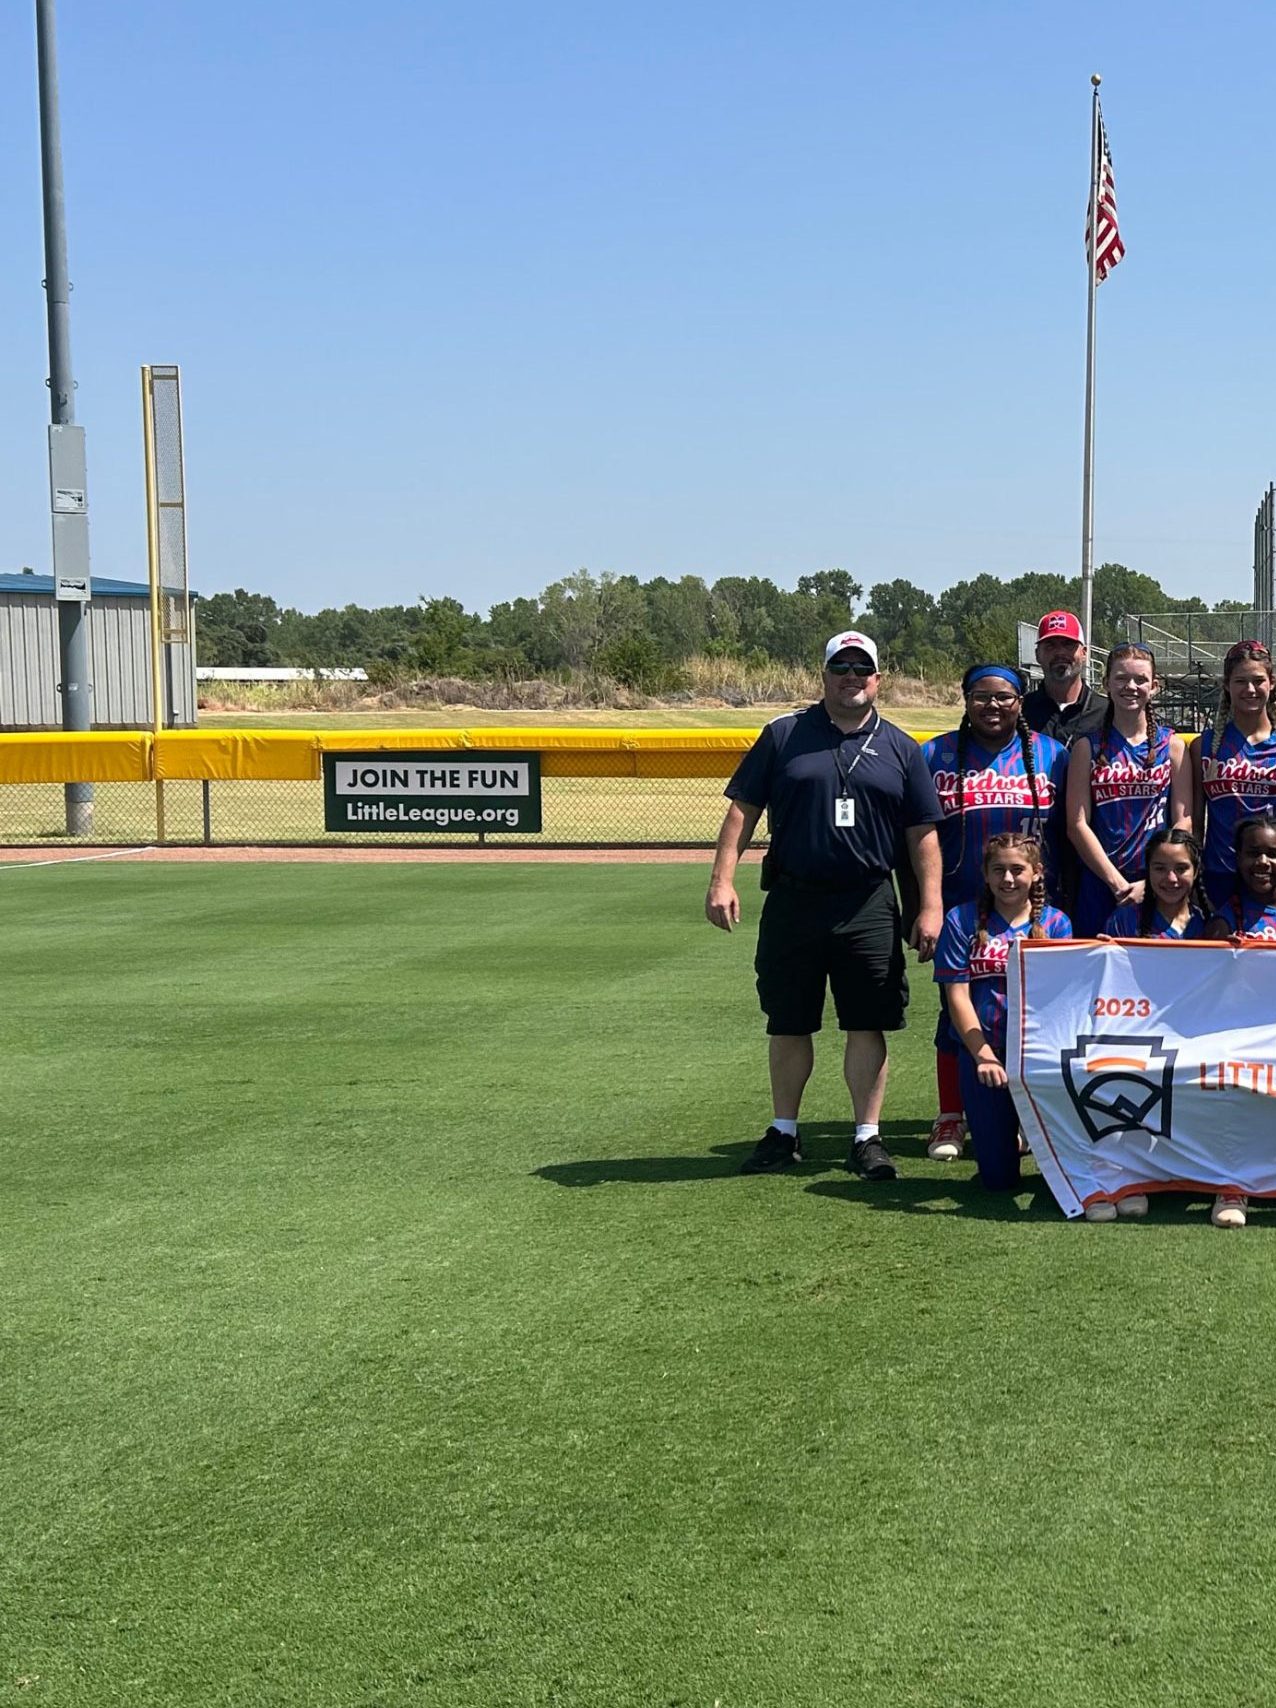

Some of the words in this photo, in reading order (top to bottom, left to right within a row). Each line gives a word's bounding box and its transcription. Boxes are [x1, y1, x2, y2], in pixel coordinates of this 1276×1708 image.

[347, 769, 409, 788] JOIN
[416, 770, 461, 788] THE
[468, 770, 519, 789] FUN
[1095, 786, 1116, 800] ALL
[1119, 785, 1158, 797] STARS
[1210, 782, 1229, 795] ALL
[1231, 781, 1270, 794] STARS
[974, 792, 1025, 805] STARS
[347, 802, 519, 826] LittleLeague.org
[1094, 998, 1151, 1017] 2023
